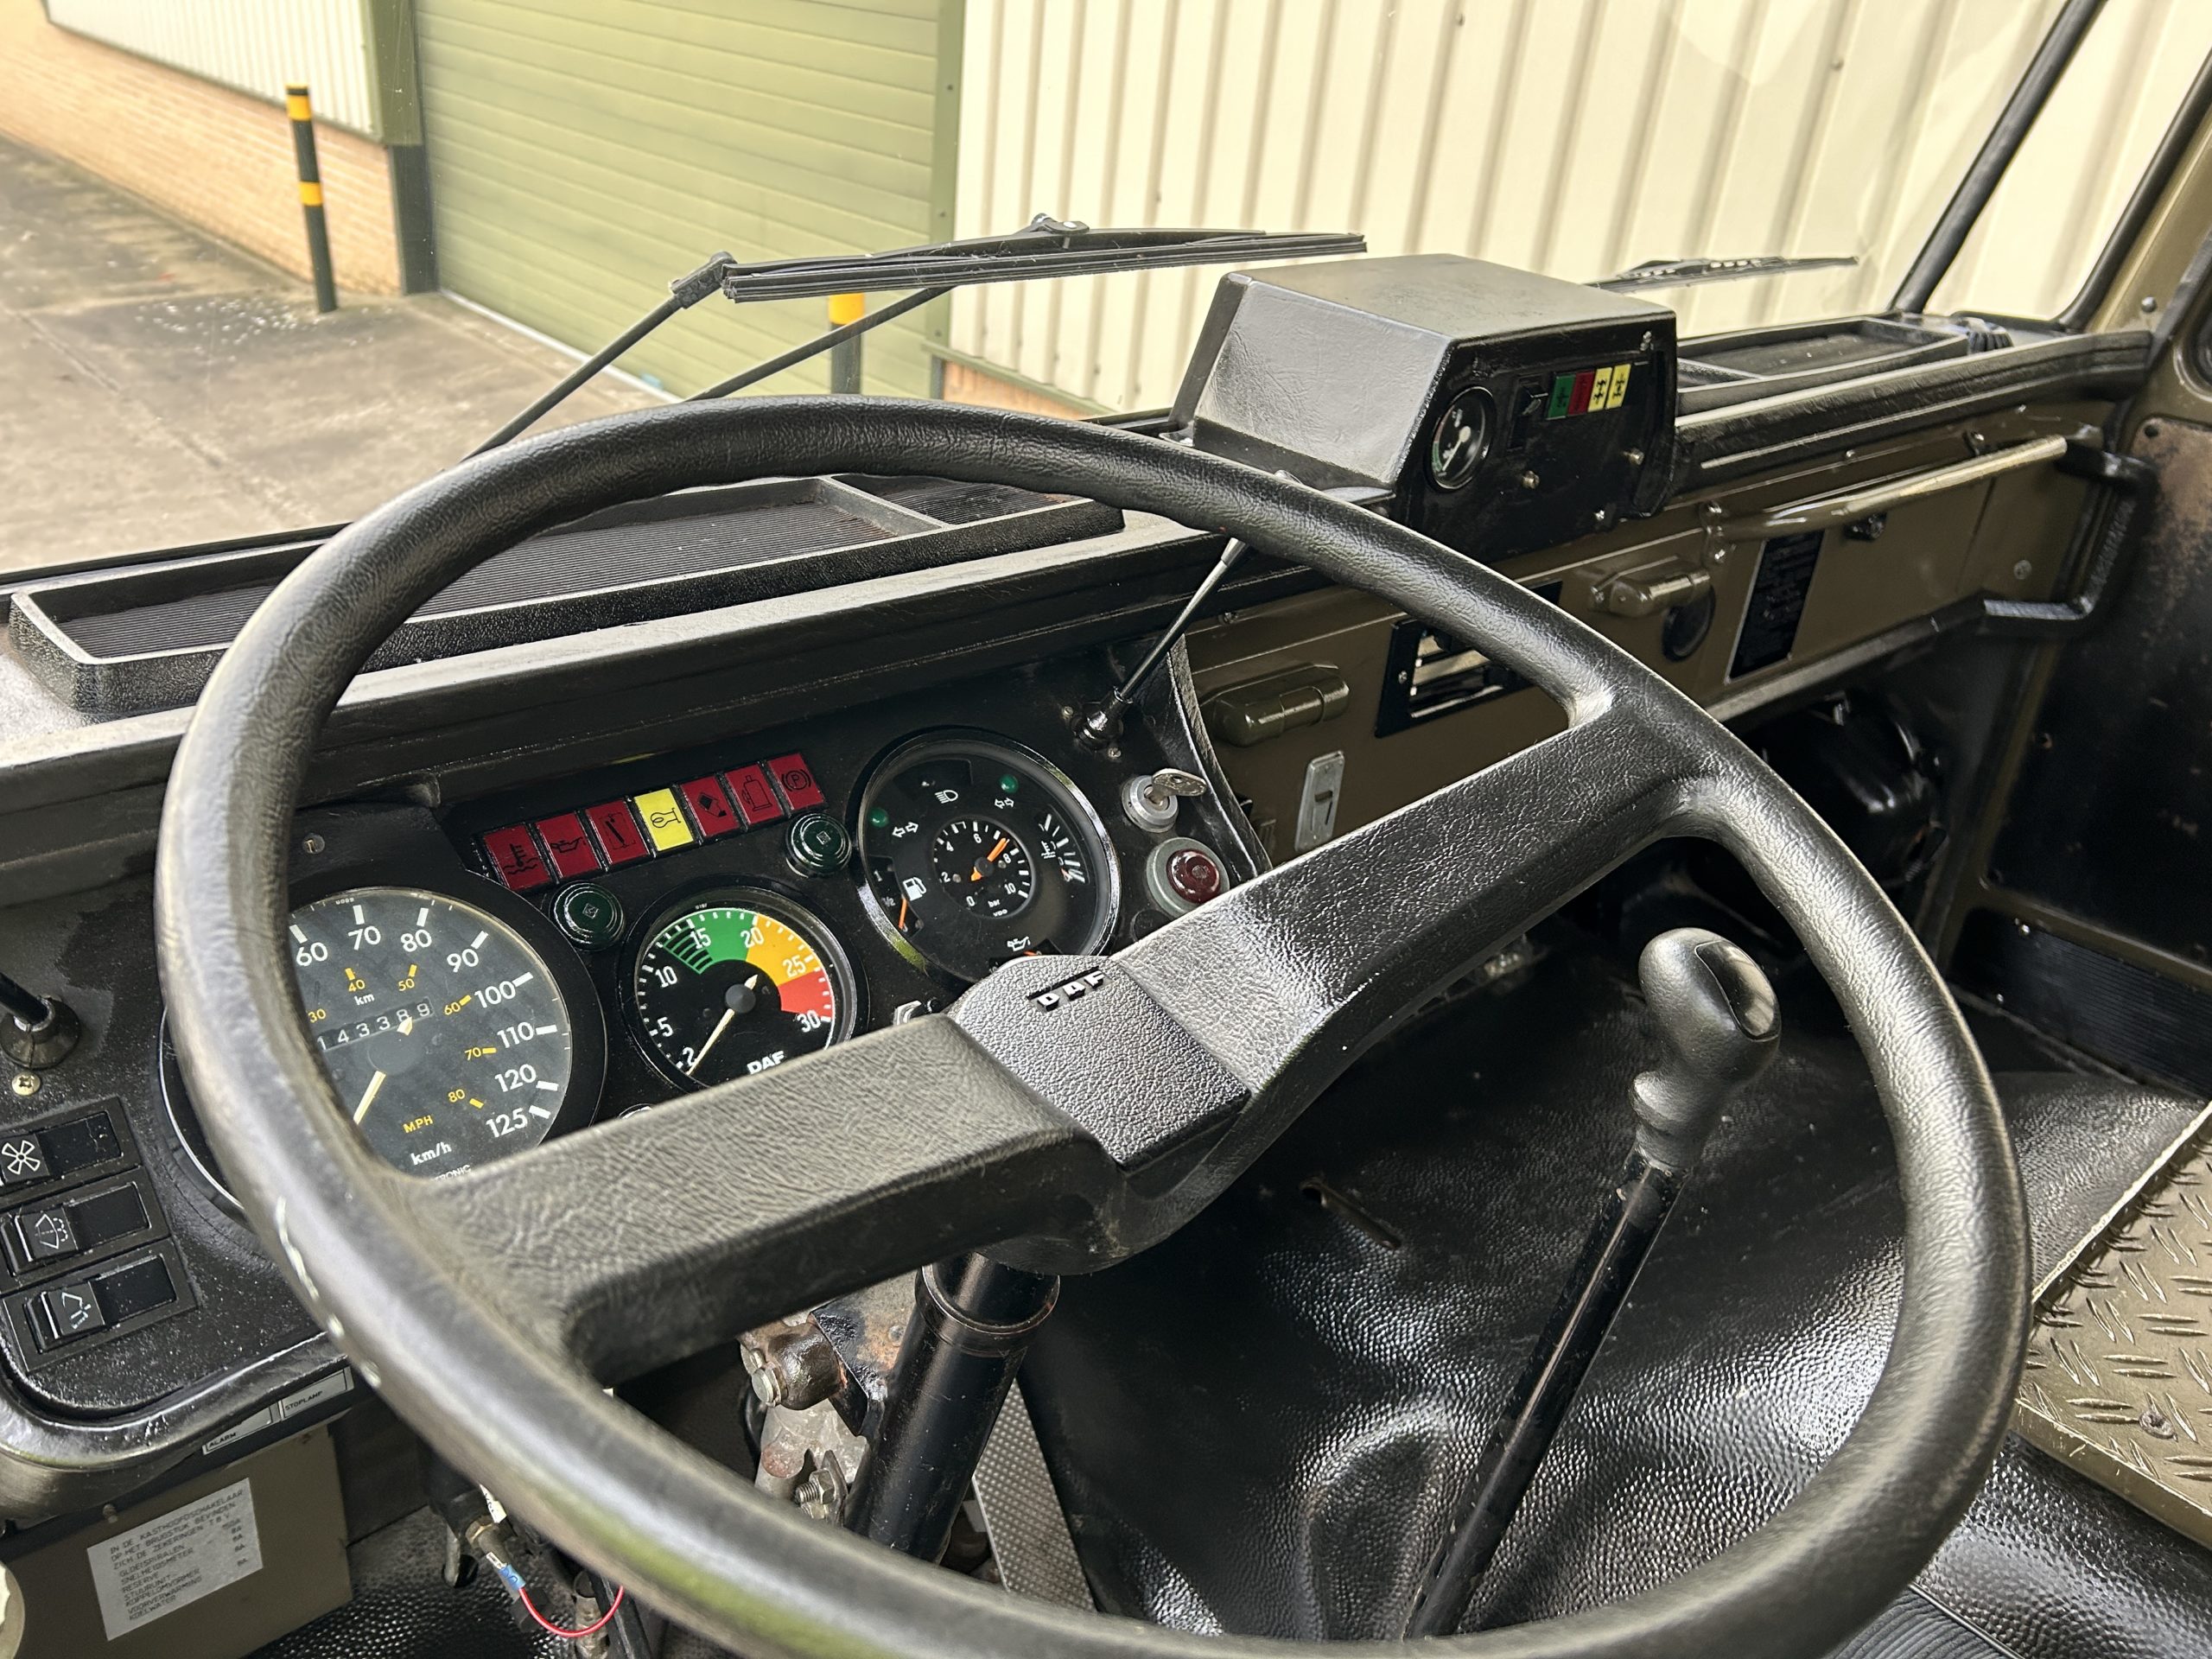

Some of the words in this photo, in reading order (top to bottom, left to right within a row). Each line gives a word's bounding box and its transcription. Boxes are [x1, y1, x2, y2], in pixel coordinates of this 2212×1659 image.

[946, 841, 954, 851] 4
[973, 833, 982, 843] 6
[1002, 853, 1011, 863] 8
[942, 872, 950, 882] 2
[1004, 883, 1016, 894] 10
[966, 895, 975, 907] 0
[988, 899, 1001, 907] bar
[347, 925, 381, 950] 70
[400, 929, 432, 952] 80
[690, 927, 712, 950] 15
[740, 926, 764, 948] 20
[296, 942, 328, 968] 60
[446, 947, 480, 973] 90
[782, 955, 807, 978] 25
[348, 979, 365, 992] 40
[397, 978, 415, 992] 50
[655, 965, 678, 988] 10
[354, 994, 375, 1006] km
[474, 981, 516, 1008] 100
[308, 1008, 327, 1023] 30
[444, 1001, 461, 1015] 60
[657, 1016, 674, 1037] 5
[797, 1009, 821, 1033] 30
[496, 1021, 534, 1049] 110
[465, 1046, 482, 1061] 70
[683, 1047, 696, 1067] 2
[747, 1051, 785, 1075] DAF
[494, 1064, 537, 1092] 120
[448, 1089, 466, 1103] 80
[403, 1115, 433, 1134] MPH
[486, 1108, 529, 1138] 125
[410, 1142, 452, 1165] km/h
[285, 1391, 322, 1410] STOPLAMP
[209, 1433, 237, 1448] ALARM
[110, 1544, 119, 1554] IN
[122, 1538, 133, 1548] DE
[124, 1544, 140, 1555] HET
